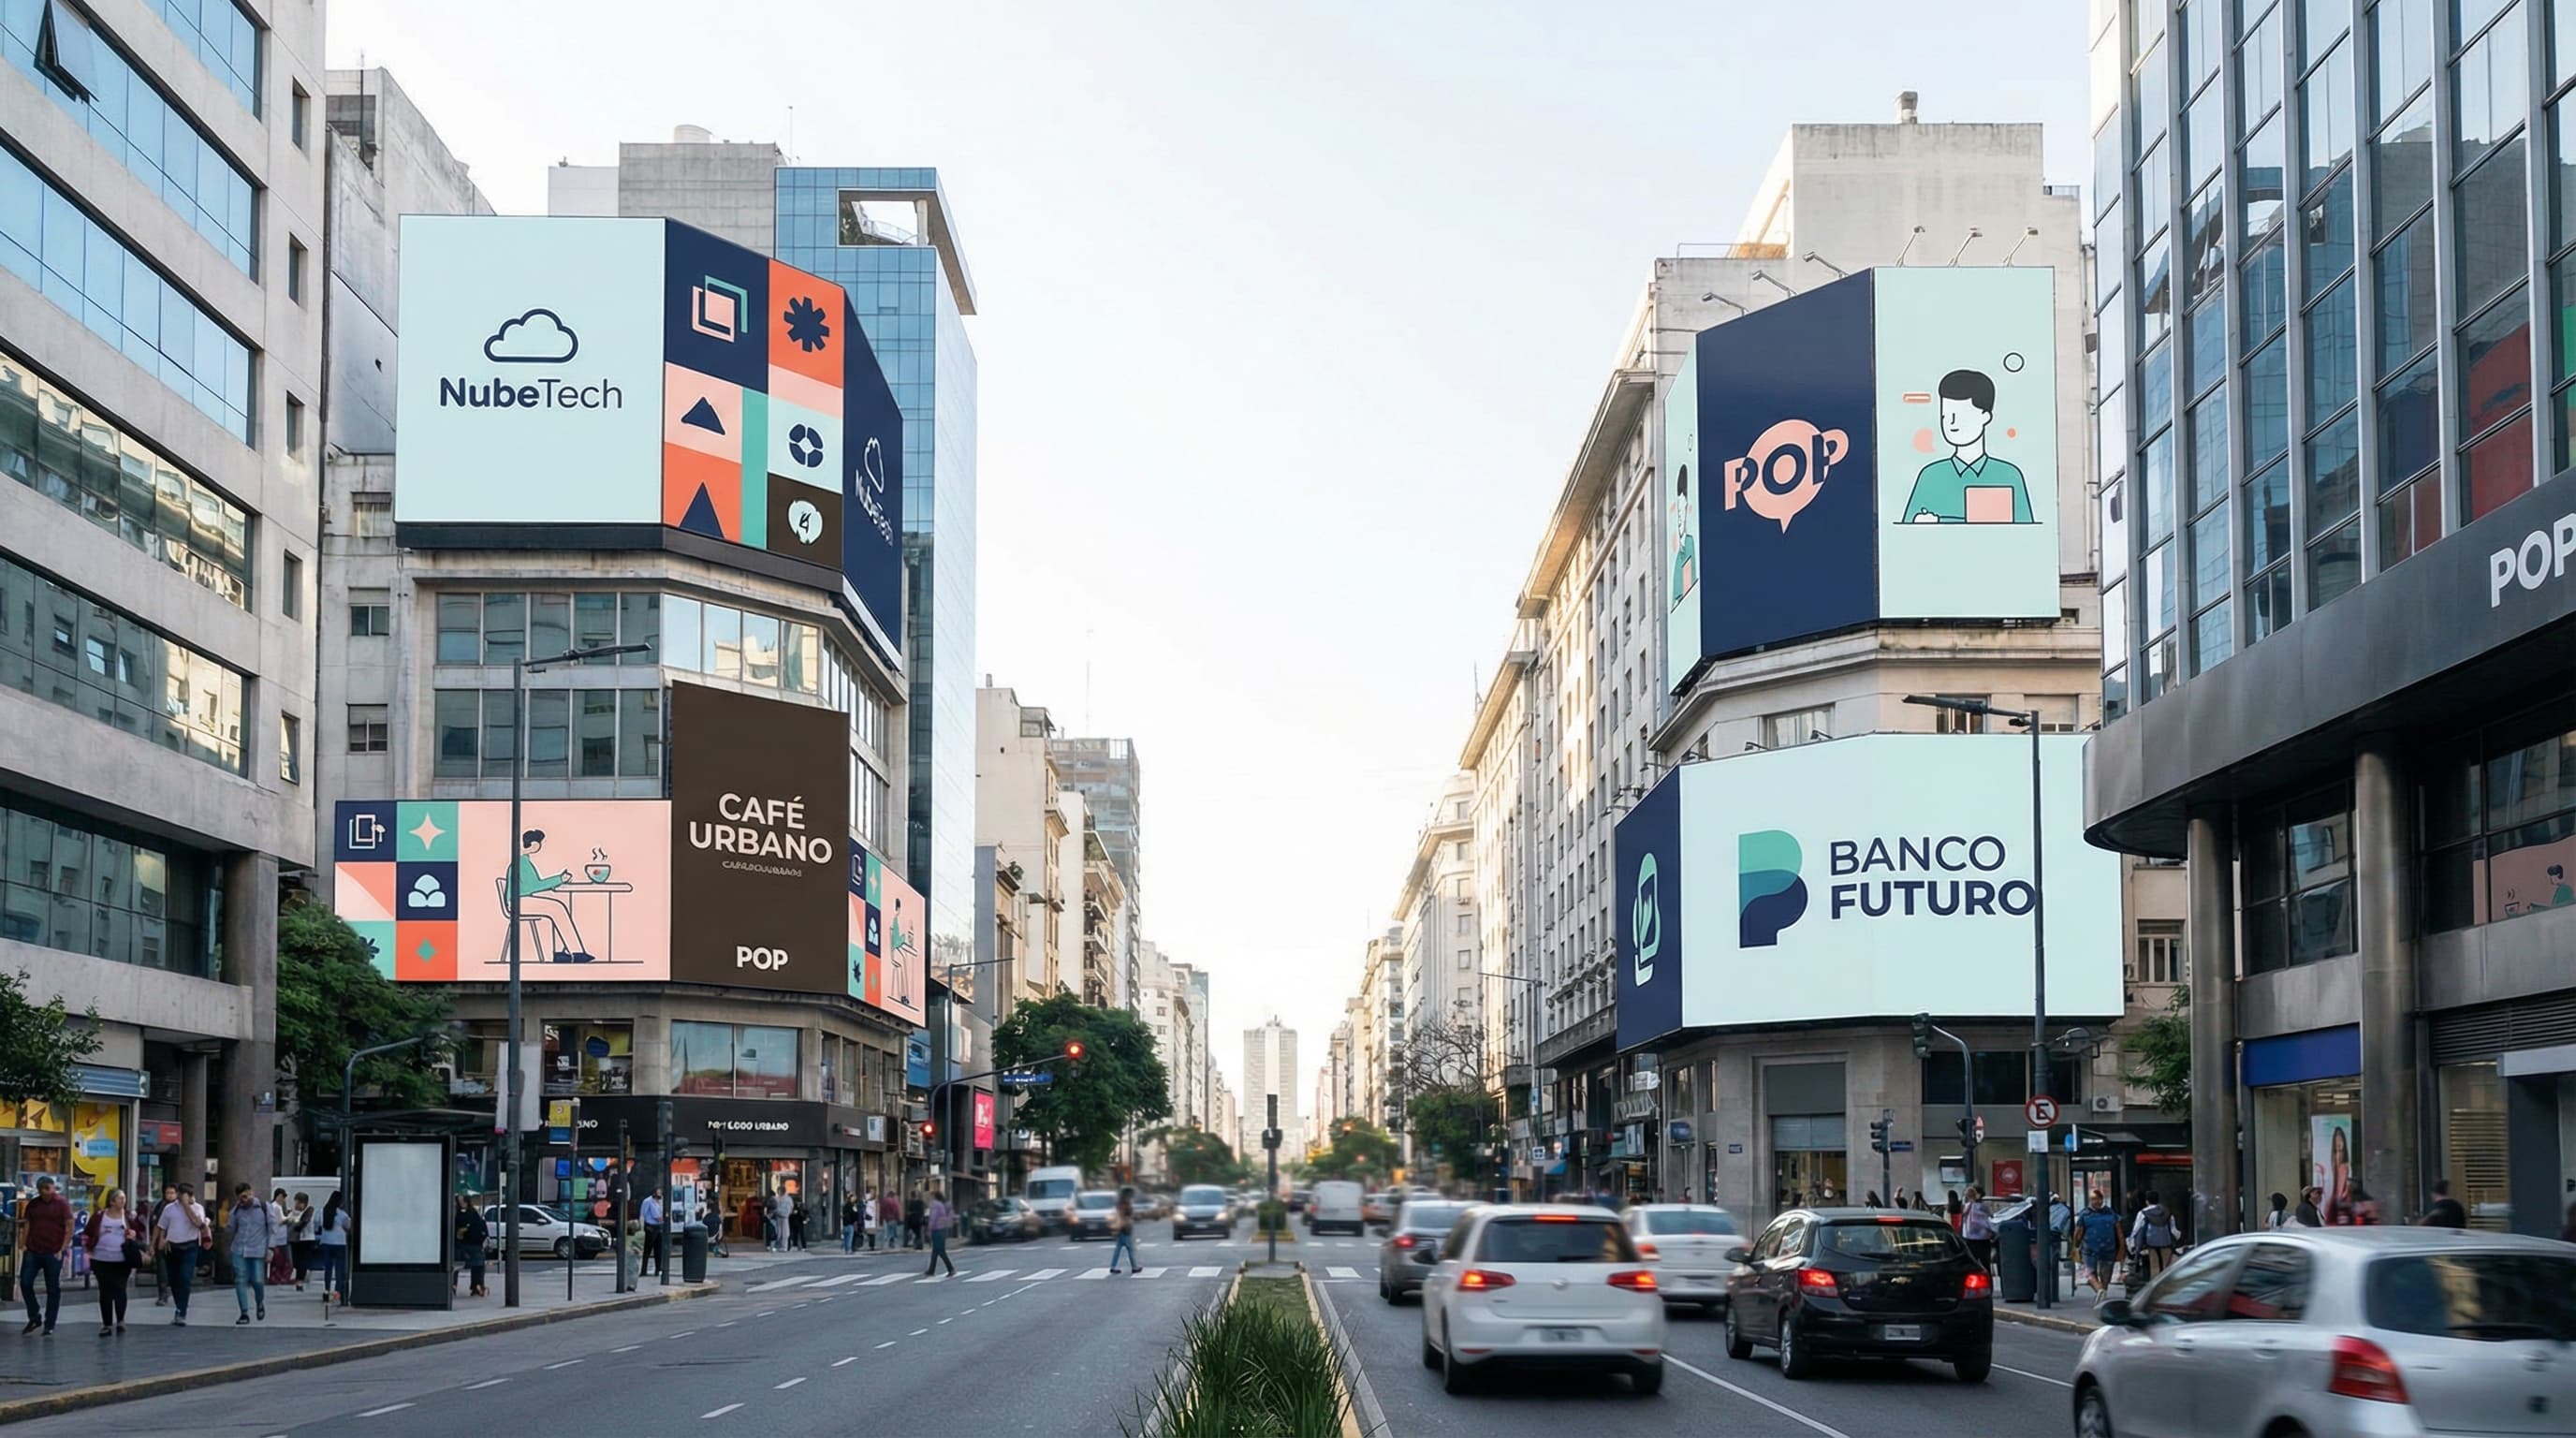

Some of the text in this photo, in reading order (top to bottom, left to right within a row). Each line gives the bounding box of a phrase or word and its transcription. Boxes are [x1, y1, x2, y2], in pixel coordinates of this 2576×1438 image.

[440, 376, 622, 409] NubeTech
[1724, 428, 1850, 511] POP
[2490, 512, 2576, 609] POP
[718, 792, 806, 830] CAFÉ
[689, 820, 833, 865] URBANO
[1830, 835, 2006, 876] BANCO
[1831, 879, 2035, 920] FUTURO
[736, 946, 789, 971] POP
